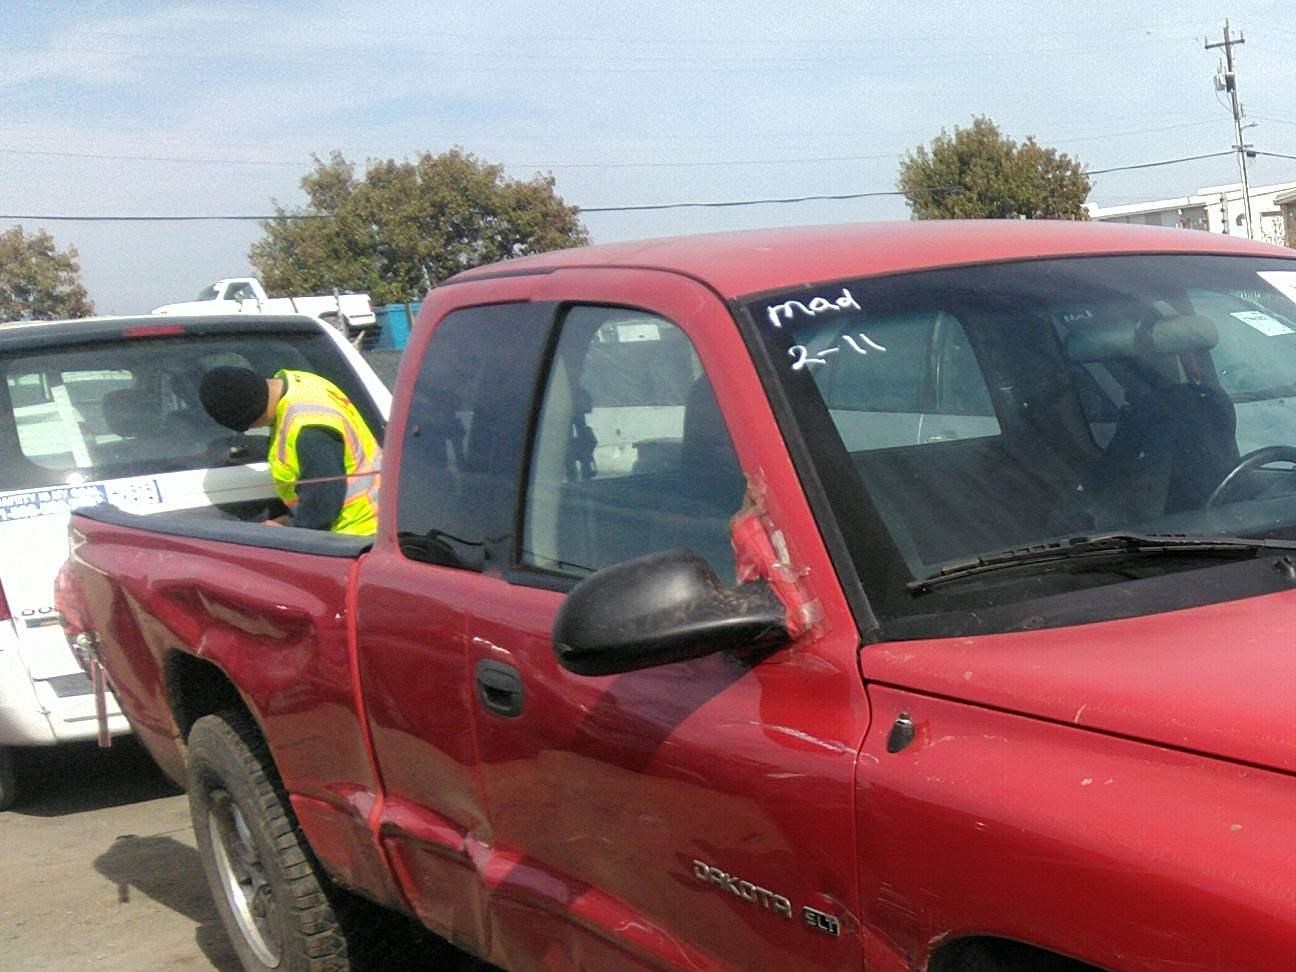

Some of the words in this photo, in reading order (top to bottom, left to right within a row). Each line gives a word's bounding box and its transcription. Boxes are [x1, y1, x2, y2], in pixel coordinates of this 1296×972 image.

[788, 333, 886, 370] 2-11
[693, 859, 792, 918] DAKOTA
[804, 909, 837, 935] SLT
